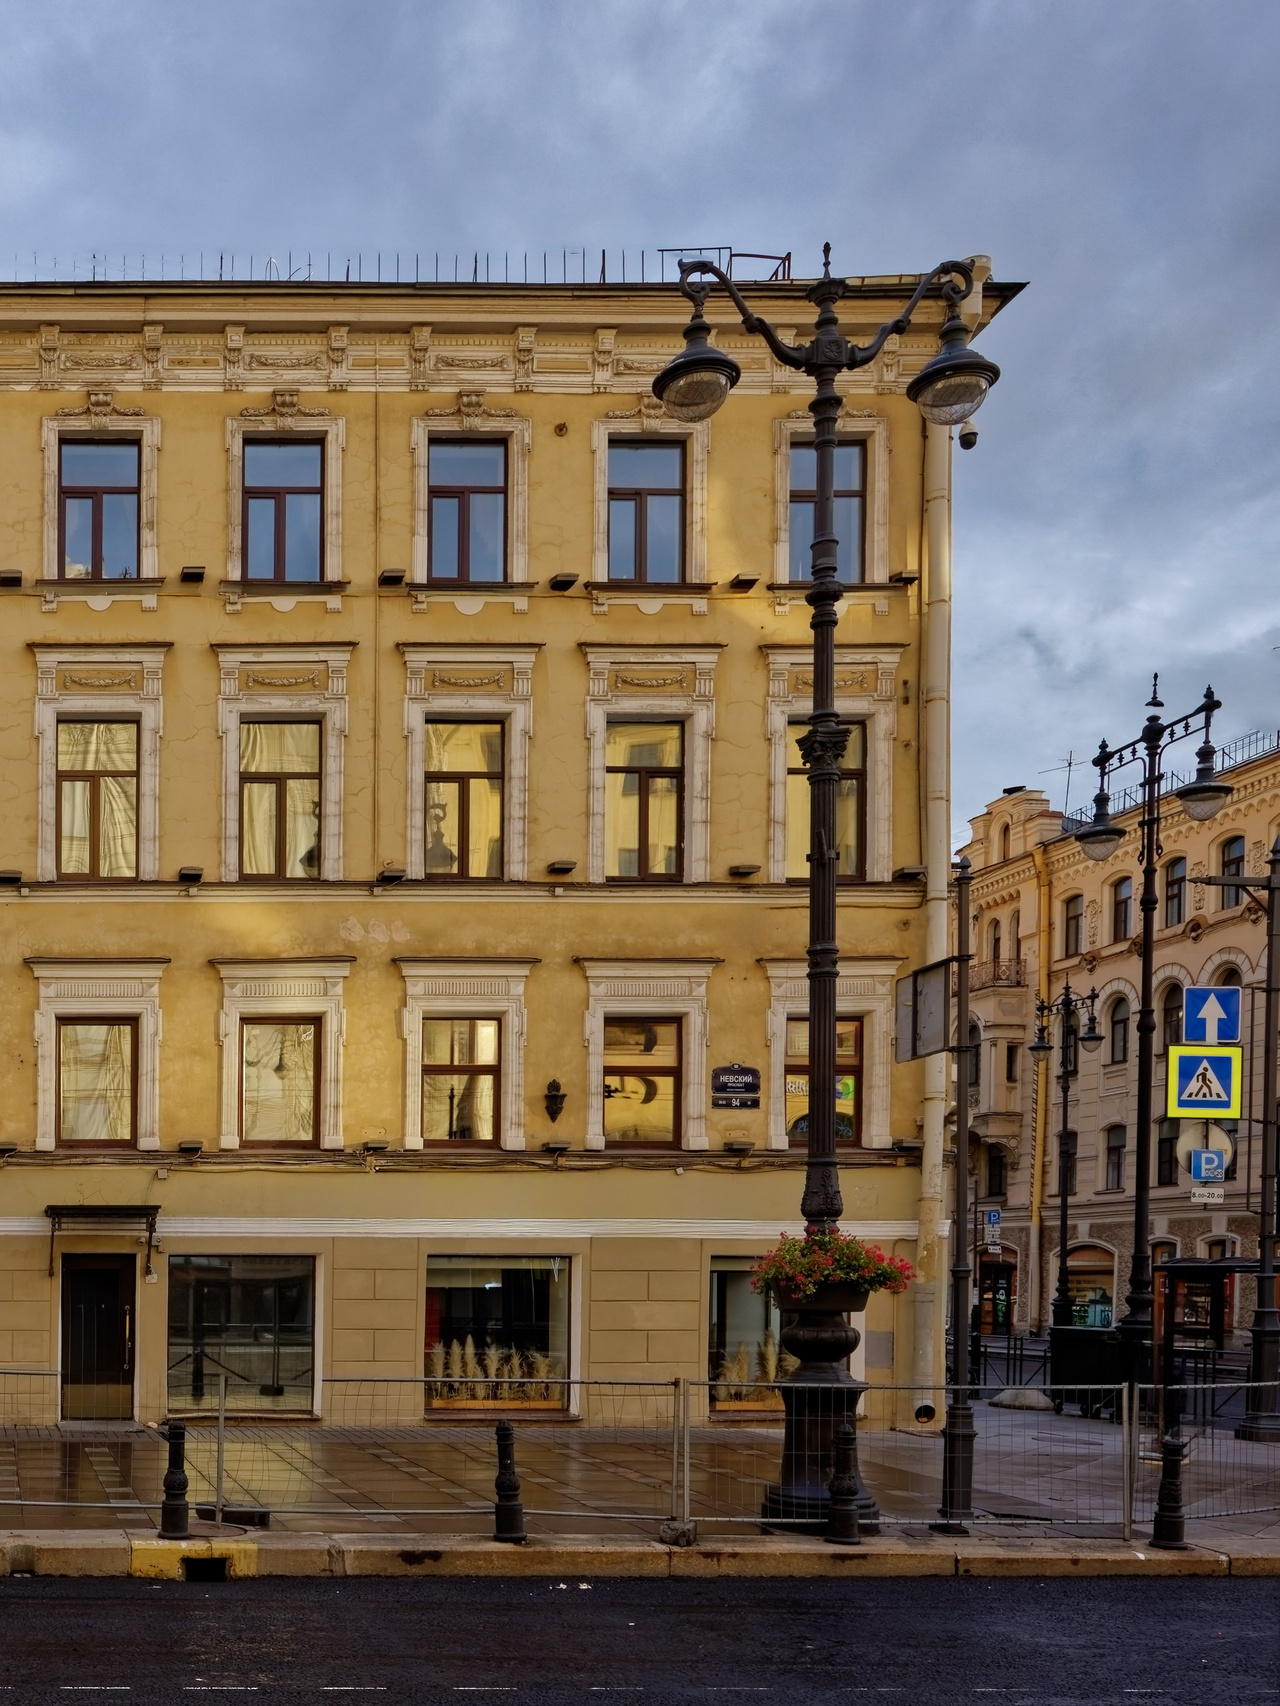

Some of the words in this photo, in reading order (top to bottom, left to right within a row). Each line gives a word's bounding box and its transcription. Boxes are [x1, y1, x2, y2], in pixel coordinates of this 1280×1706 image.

[720, 1074, 753, 1083] НЕВСКИЙ
[731, 1098, 740, 1107] 94
[1201, 1153, 1219, 1177] P
[1191, 1191, 1224, 1199] 8.00-20.00
